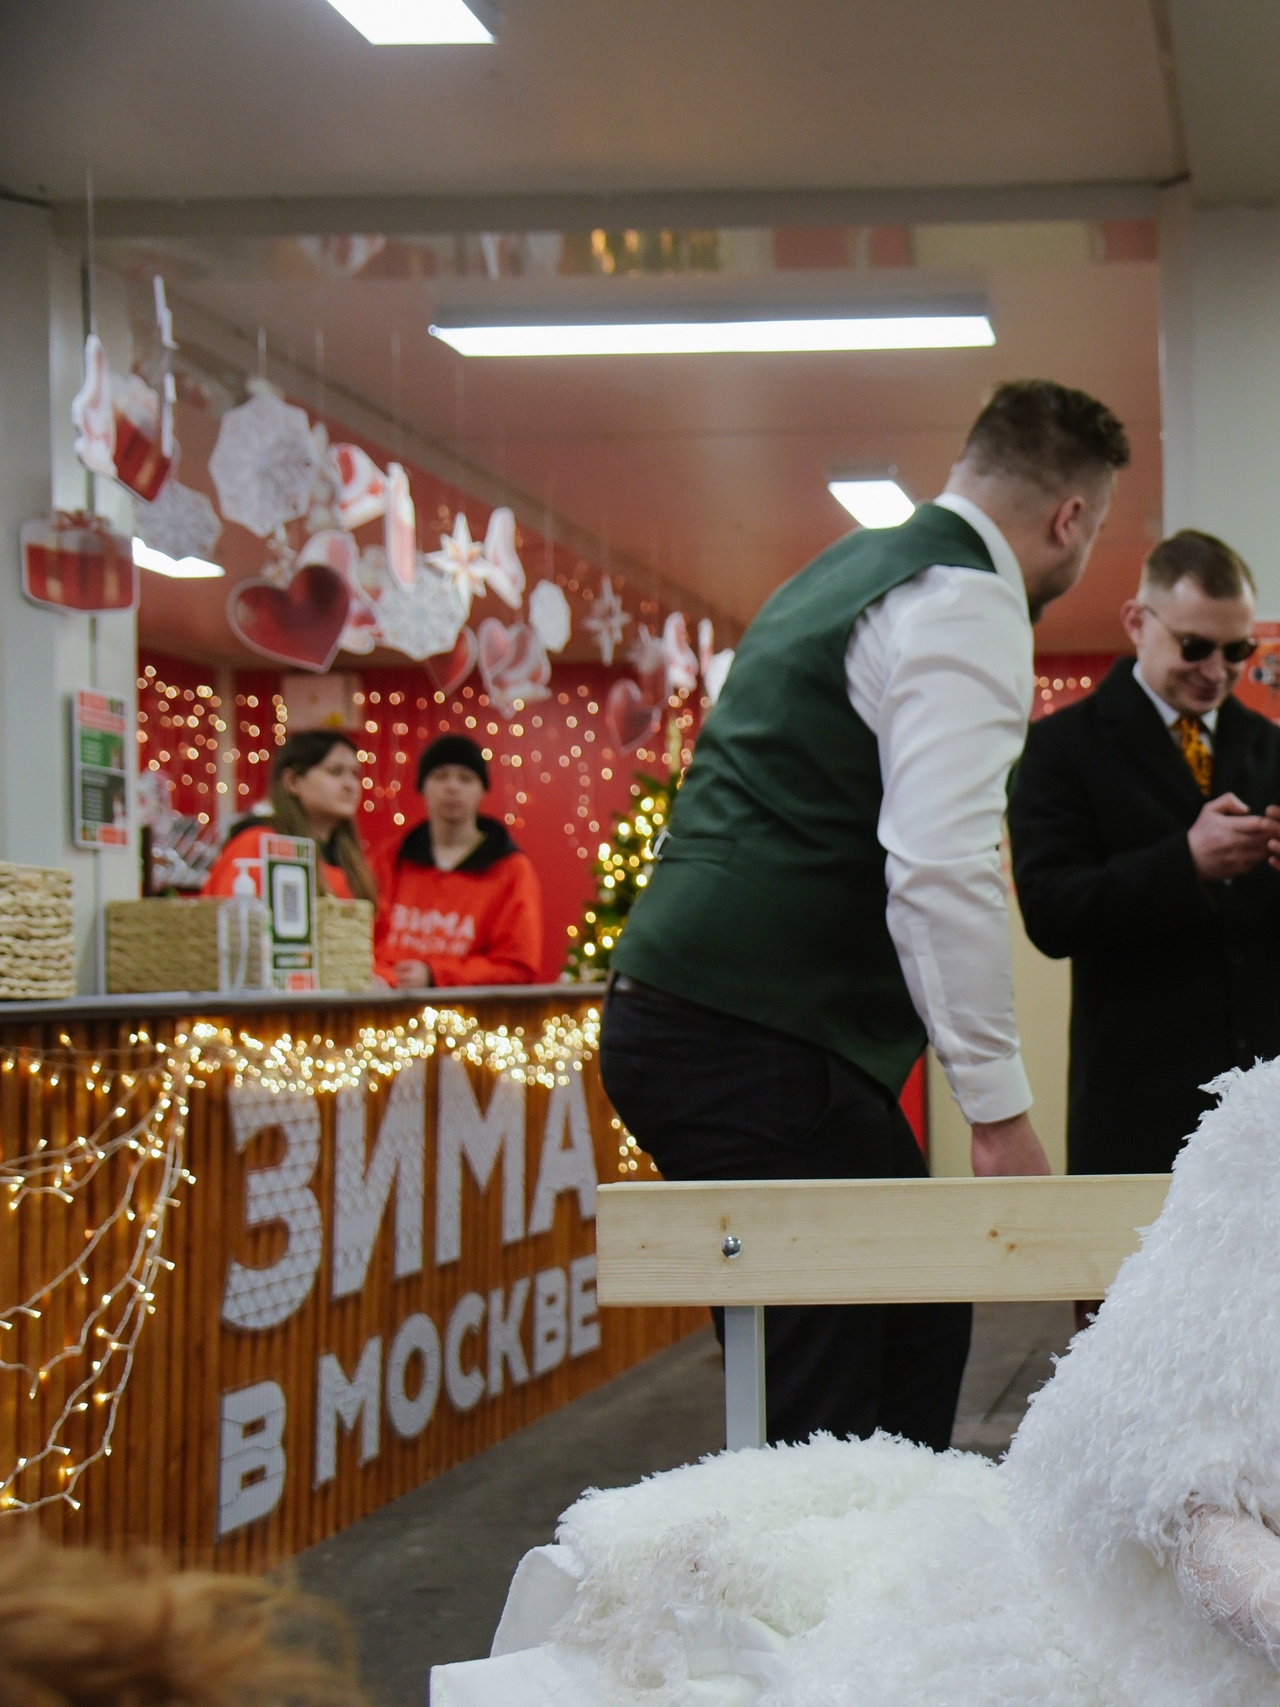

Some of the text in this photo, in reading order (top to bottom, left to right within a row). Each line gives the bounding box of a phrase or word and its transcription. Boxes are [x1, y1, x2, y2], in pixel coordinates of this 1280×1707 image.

[221, 1053, 598, 1331] ЗИМА
[216, 1256, 601, 1542] В МОСКВЕ
